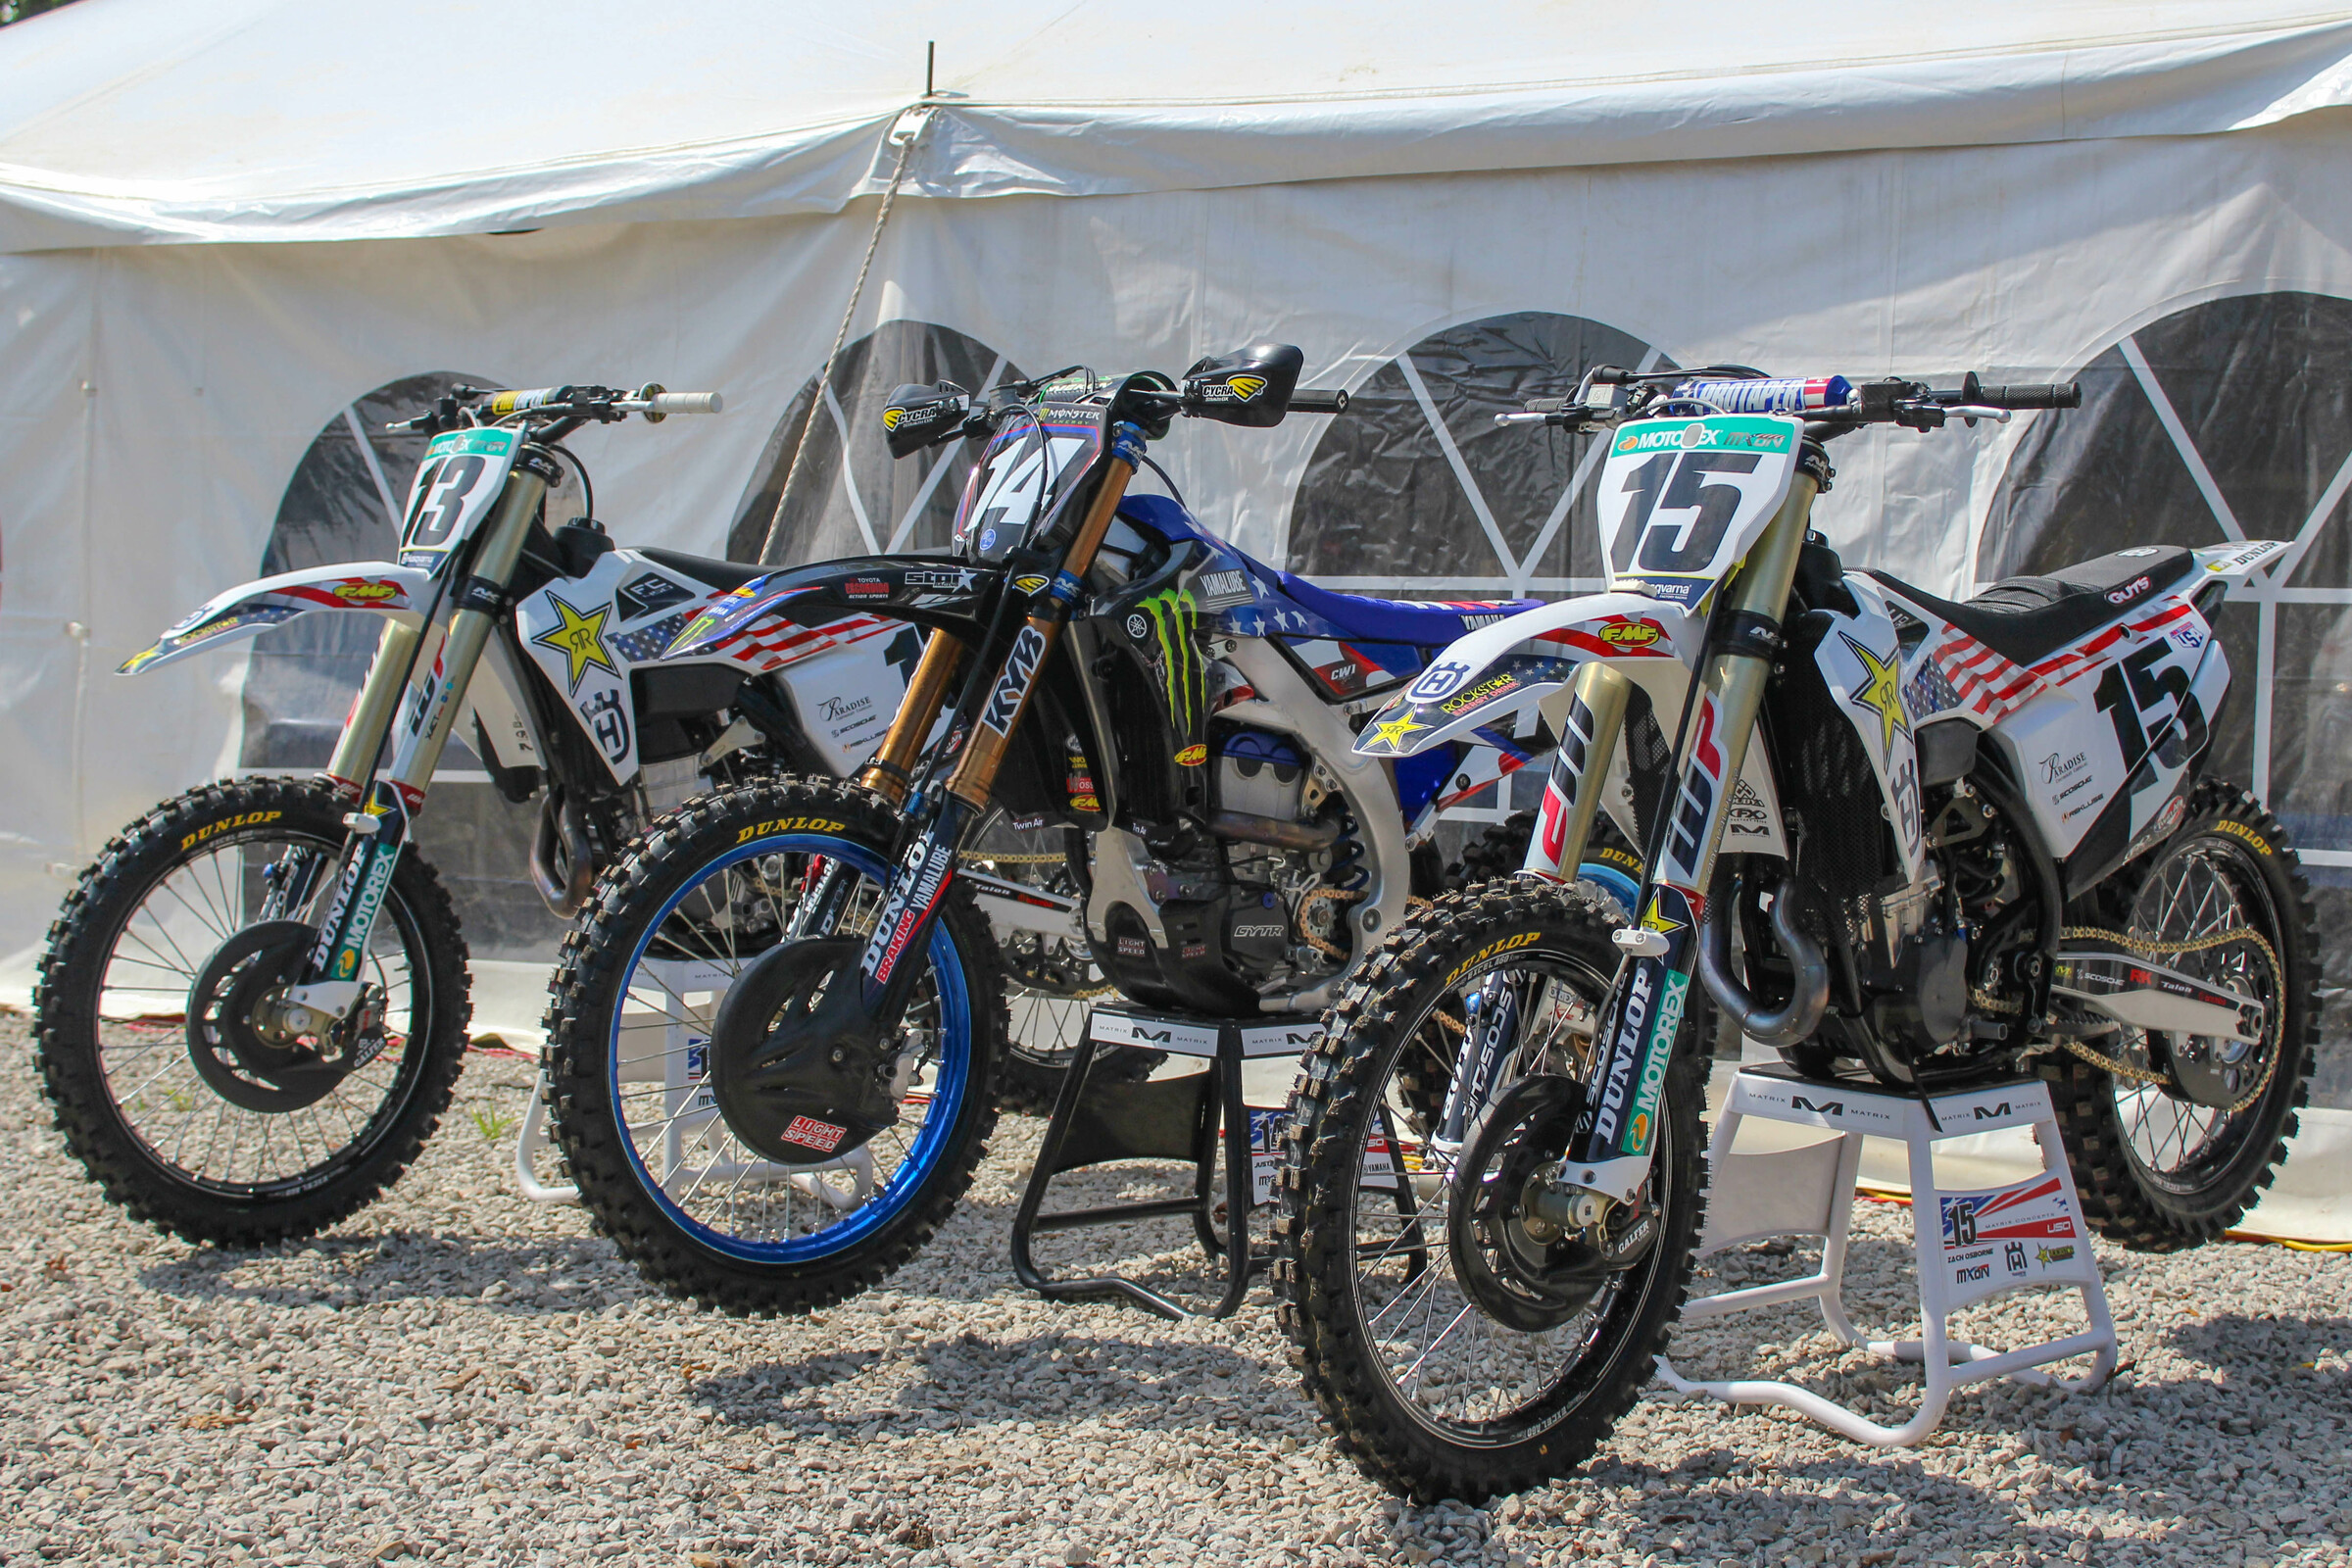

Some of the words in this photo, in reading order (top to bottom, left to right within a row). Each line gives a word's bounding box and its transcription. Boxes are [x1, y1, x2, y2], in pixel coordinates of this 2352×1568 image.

[1202, 385, 1234, 397] CYCRA
[898, 407, 937, 424] CYCRA
[1048, 408, 1101, 420] MONSTER
[1638, 429, 1719, 450] MOTOEX
[964, 436, 1086, 533] 14
[401, 456, 486, 547] 13
[1610, 452, 1763, 572] 15
[2232, 542, 2280, 565] DUNLOP
[334, 583, 397, 599] FMF
[1200, 570, 1247, 597] YAMALUBE
[2108, 576, 2150, 604] GUTS
[1601, 624, 1657, 642] FMF
[982, 625, 1046, 739] KYB
[1451, 695, 1489, 716] ENERGY
[1490, 680, 1520, 697] DRINK
[2093, 637, 2208, 796] 15
[1070, 797, 1100, 808] FM
[180, 811, 282, 851] DUNLOP
[736, 817, 845, 845] DUNLOP
[1012, 820, 1032, 830] Twin
[1033, 817, 1044, 827] Air
[2214, 820, 2274, 856] DUNLOP
[1599, 847, 1644, 874] DUNL
[910, 844, 953, 910] YAMALUBE
[975, 883, 1010, 895] Talon
[313, 841, 368, 971] DUNLOP
[345, 850, 395, 950] MOTOREX
[1117, 938, 1145, 947] LIGHT
[1234, 925, 1285, 938] GYTR
[875, 908, 914, 984] BRAKING
[1117, 947, 1145, 956] SPEED
[1445, 932, 1542, 987] DUNLOP
[1467, 961, 1494, 980] EXCEL
[2083, 972, 2126, 986] SCOSCHE
[2130, 968, 2153, 985] RK
[2161, 980, 2192, 994] Talon
[1100, 1025, 1127, 1034] MATRIX
[1177, 1036, 1208, 1045] MATRIX
[1638, 976, 1687, 1110] MOTOREX
[1594, 967, 1652, 1145] DUNLOP
[1749, 1093, 1786, 1103] MATRIX
[1850, 1108, 1891, 1120] MATRIX
[1941, 1112, 1970, 1122] MATRIX
[2015, 1101, 2041, 1110] MATRIX
[783, 1127, 837, 1152] SPEED
[792, 1115, 847, 1140] LIGHT
[1368, 1162, 1391, 1173] YAMAHA
[1618, 1220, 1649, 1254] GALFER
[1948, 1203, 1977, 1247] 15
